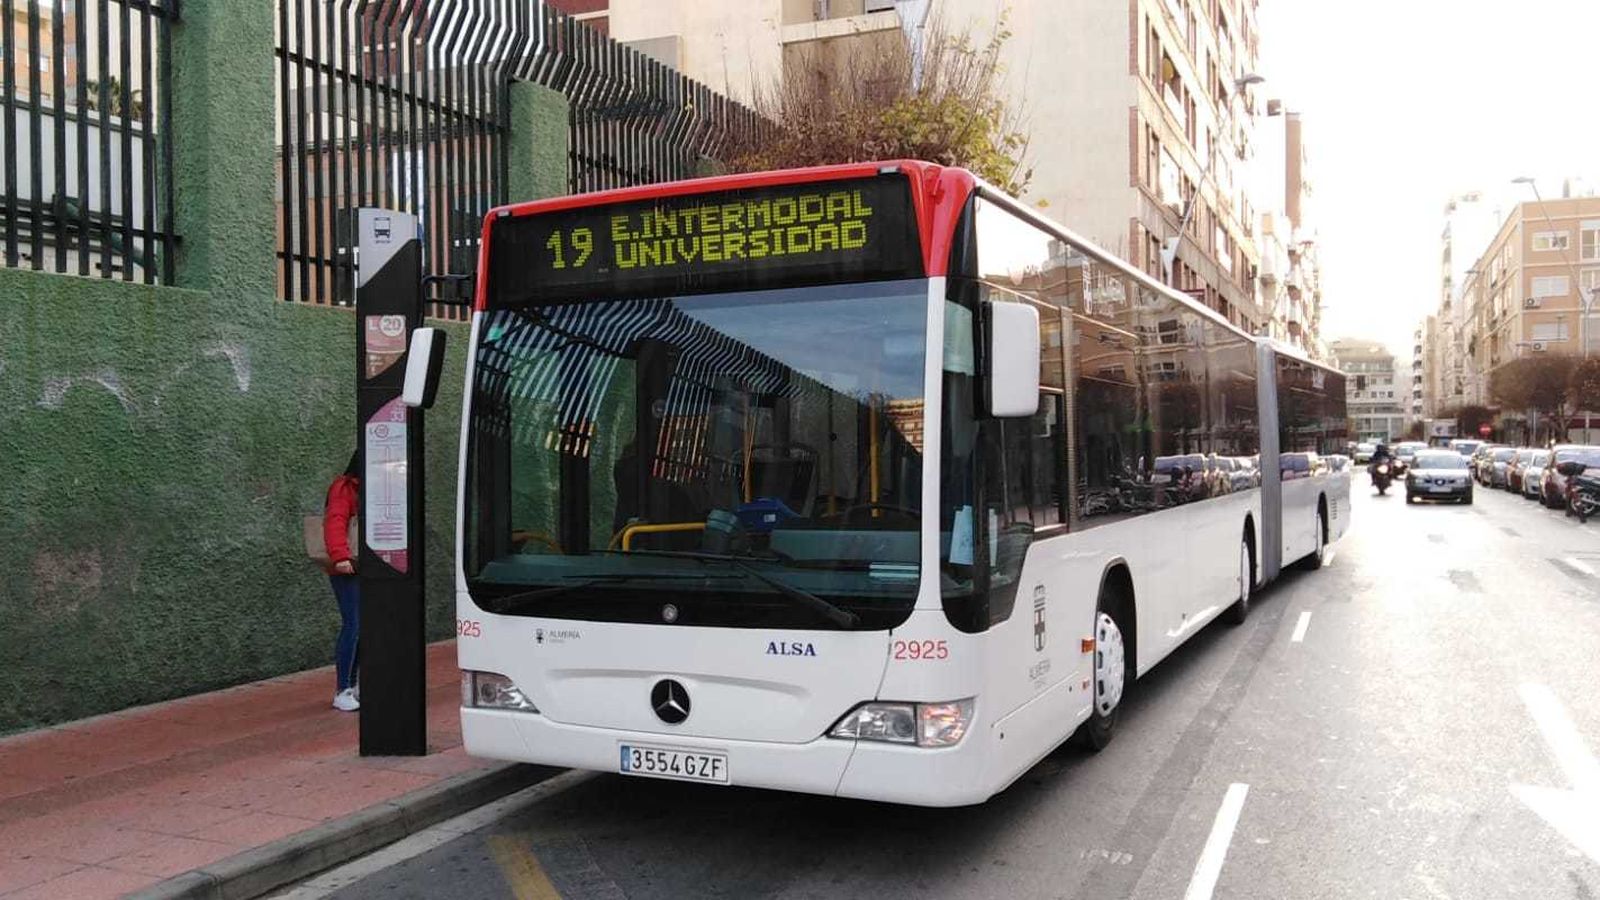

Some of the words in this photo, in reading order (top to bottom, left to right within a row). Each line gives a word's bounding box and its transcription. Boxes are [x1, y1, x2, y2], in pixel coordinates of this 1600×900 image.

[611, 190, 873, 241] E.INTERMODAL
[546, 228, 593, 269] 19
[614, 219, 868, 269] UNIVERSIDAD
[766, 641, 817, 657] ALSA
[893, 640, 949, 660] 2925
